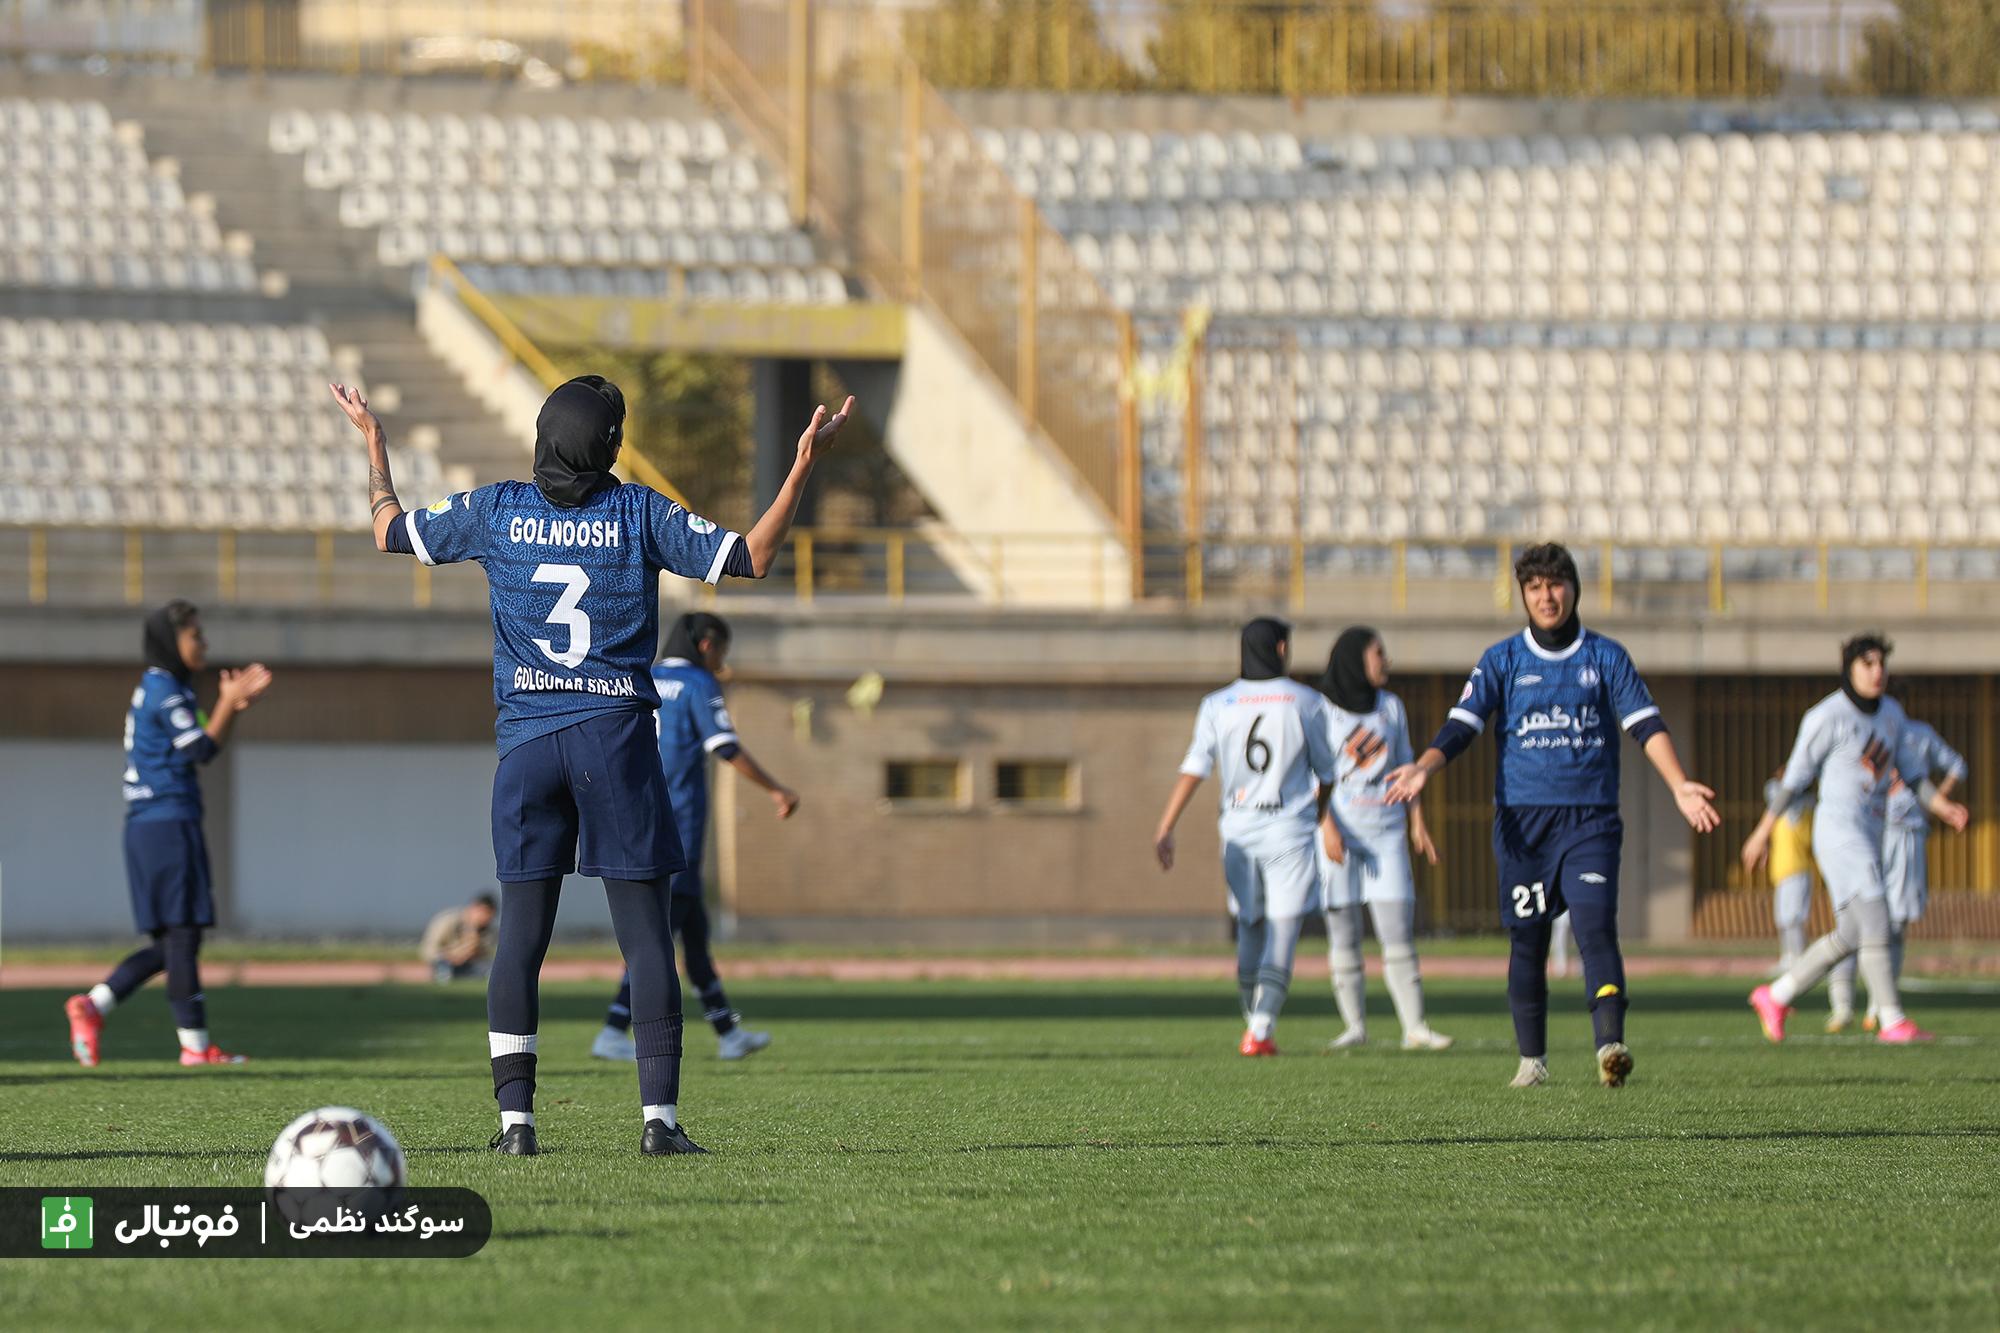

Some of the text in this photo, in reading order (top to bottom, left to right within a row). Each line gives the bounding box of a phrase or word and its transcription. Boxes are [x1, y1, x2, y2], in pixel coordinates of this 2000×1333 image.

[509, 516, 619, 548] GOLNOOSH
[530, 563, 591, 669] 3
[587, 677, 638, 697] SIRJAN
[1516, 703, 1571, 737] گهر
[1245, 713, 1272, 776] 6
[1511, 882, 1548, 919] 21
